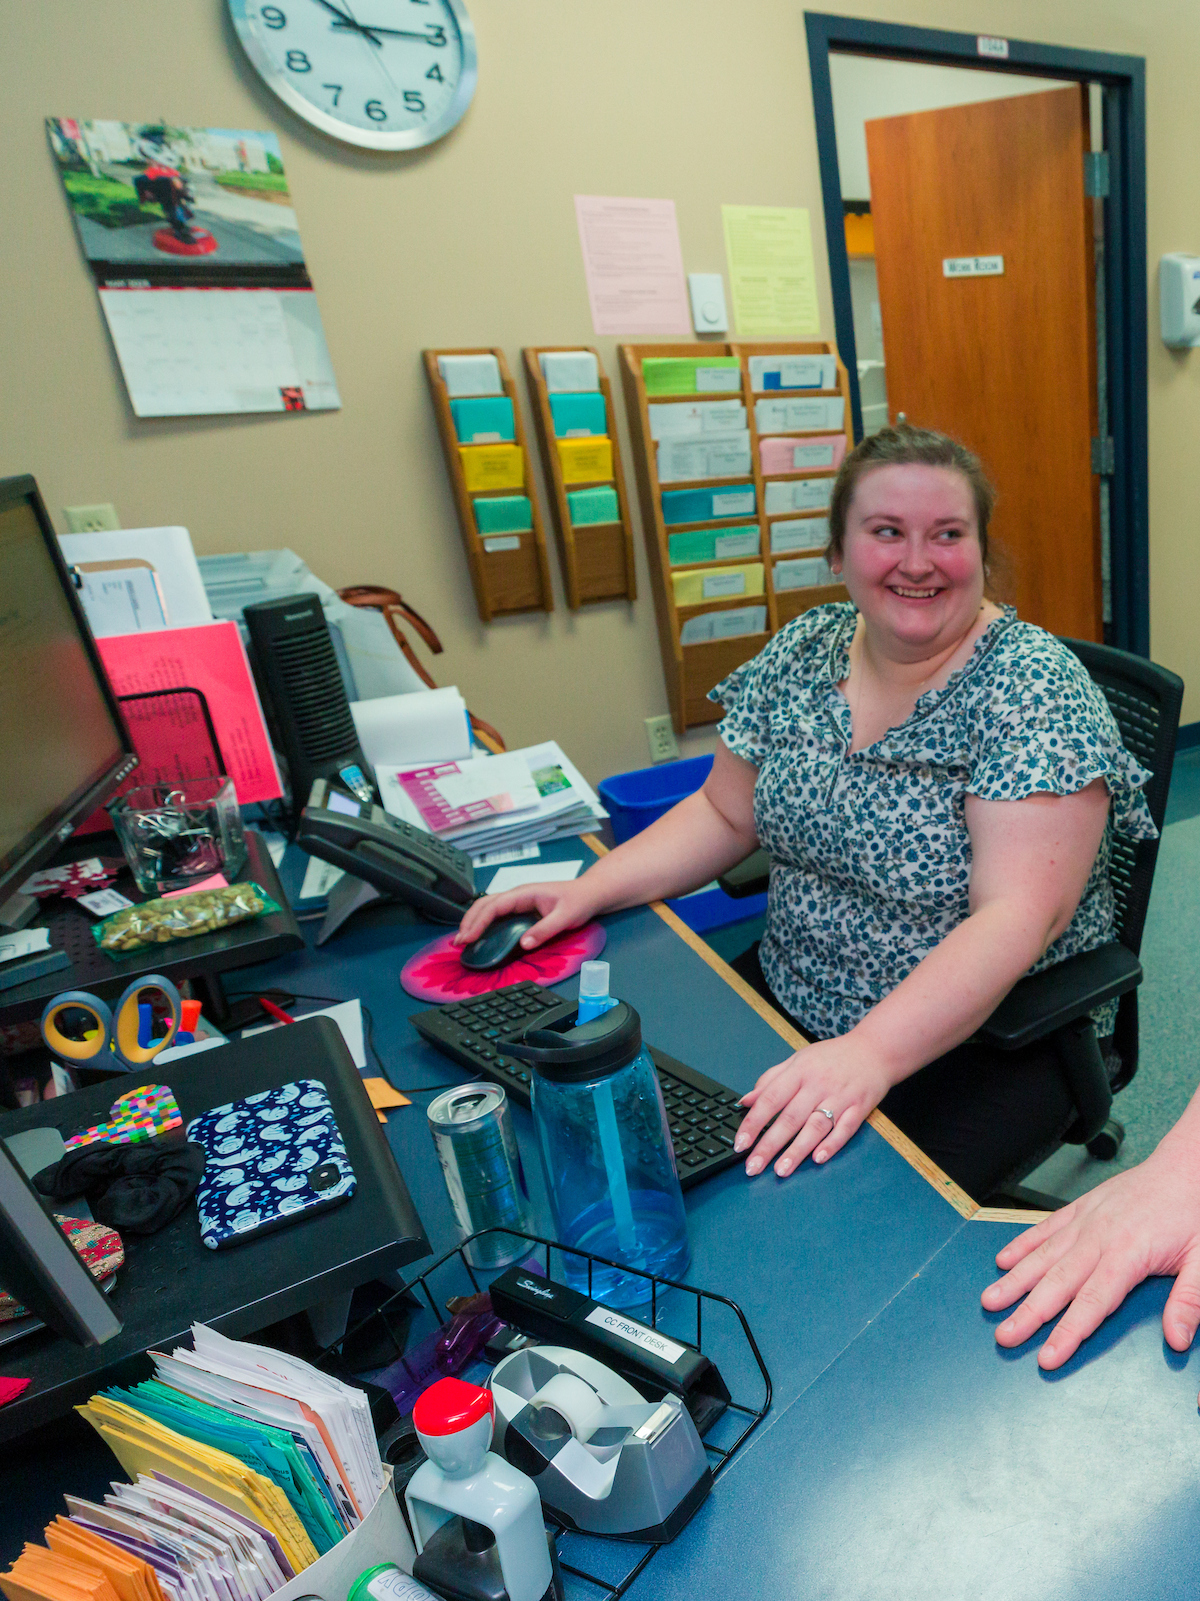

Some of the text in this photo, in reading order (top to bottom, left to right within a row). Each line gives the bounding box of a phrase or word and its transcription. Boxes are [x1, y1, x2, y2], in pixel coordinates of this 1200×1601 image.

[260, 6, 287, 30] 9
[425, 24, 447, 47] 3
[286, 50, 312, 73] 8
[425, 63, 444, 84] 4
[322, 83, 342, 106] 7
[403, 90, 425, 113] 5
[365, 100, 387, 122] 6
[604, 1316, 668, 1351] CC FRONT DESK
